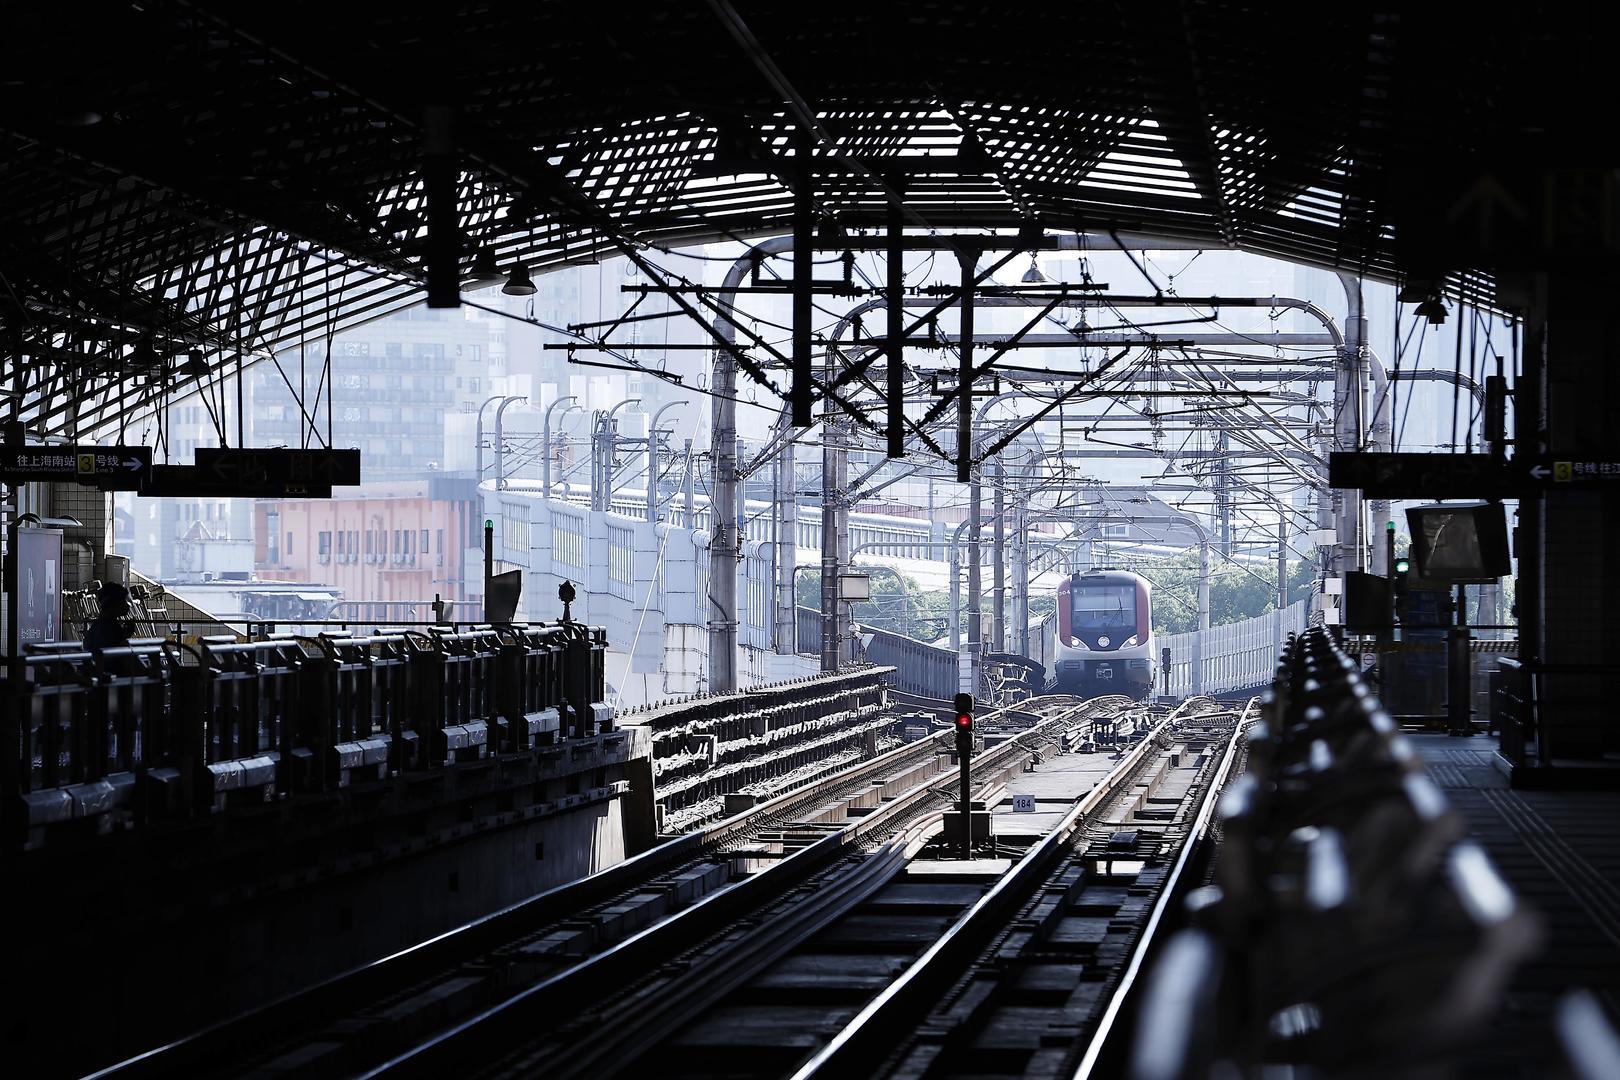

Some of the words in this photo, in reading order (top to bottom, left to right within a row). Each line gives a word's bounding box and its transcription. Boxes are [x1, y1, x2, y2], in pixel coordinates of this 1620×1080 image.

[17, 455, 75, 467] 往上海南站
[80, 456, 92, 472] 3
[96, 455, 119, 467] 号线
[1016, 800, 1030, 808] 184
